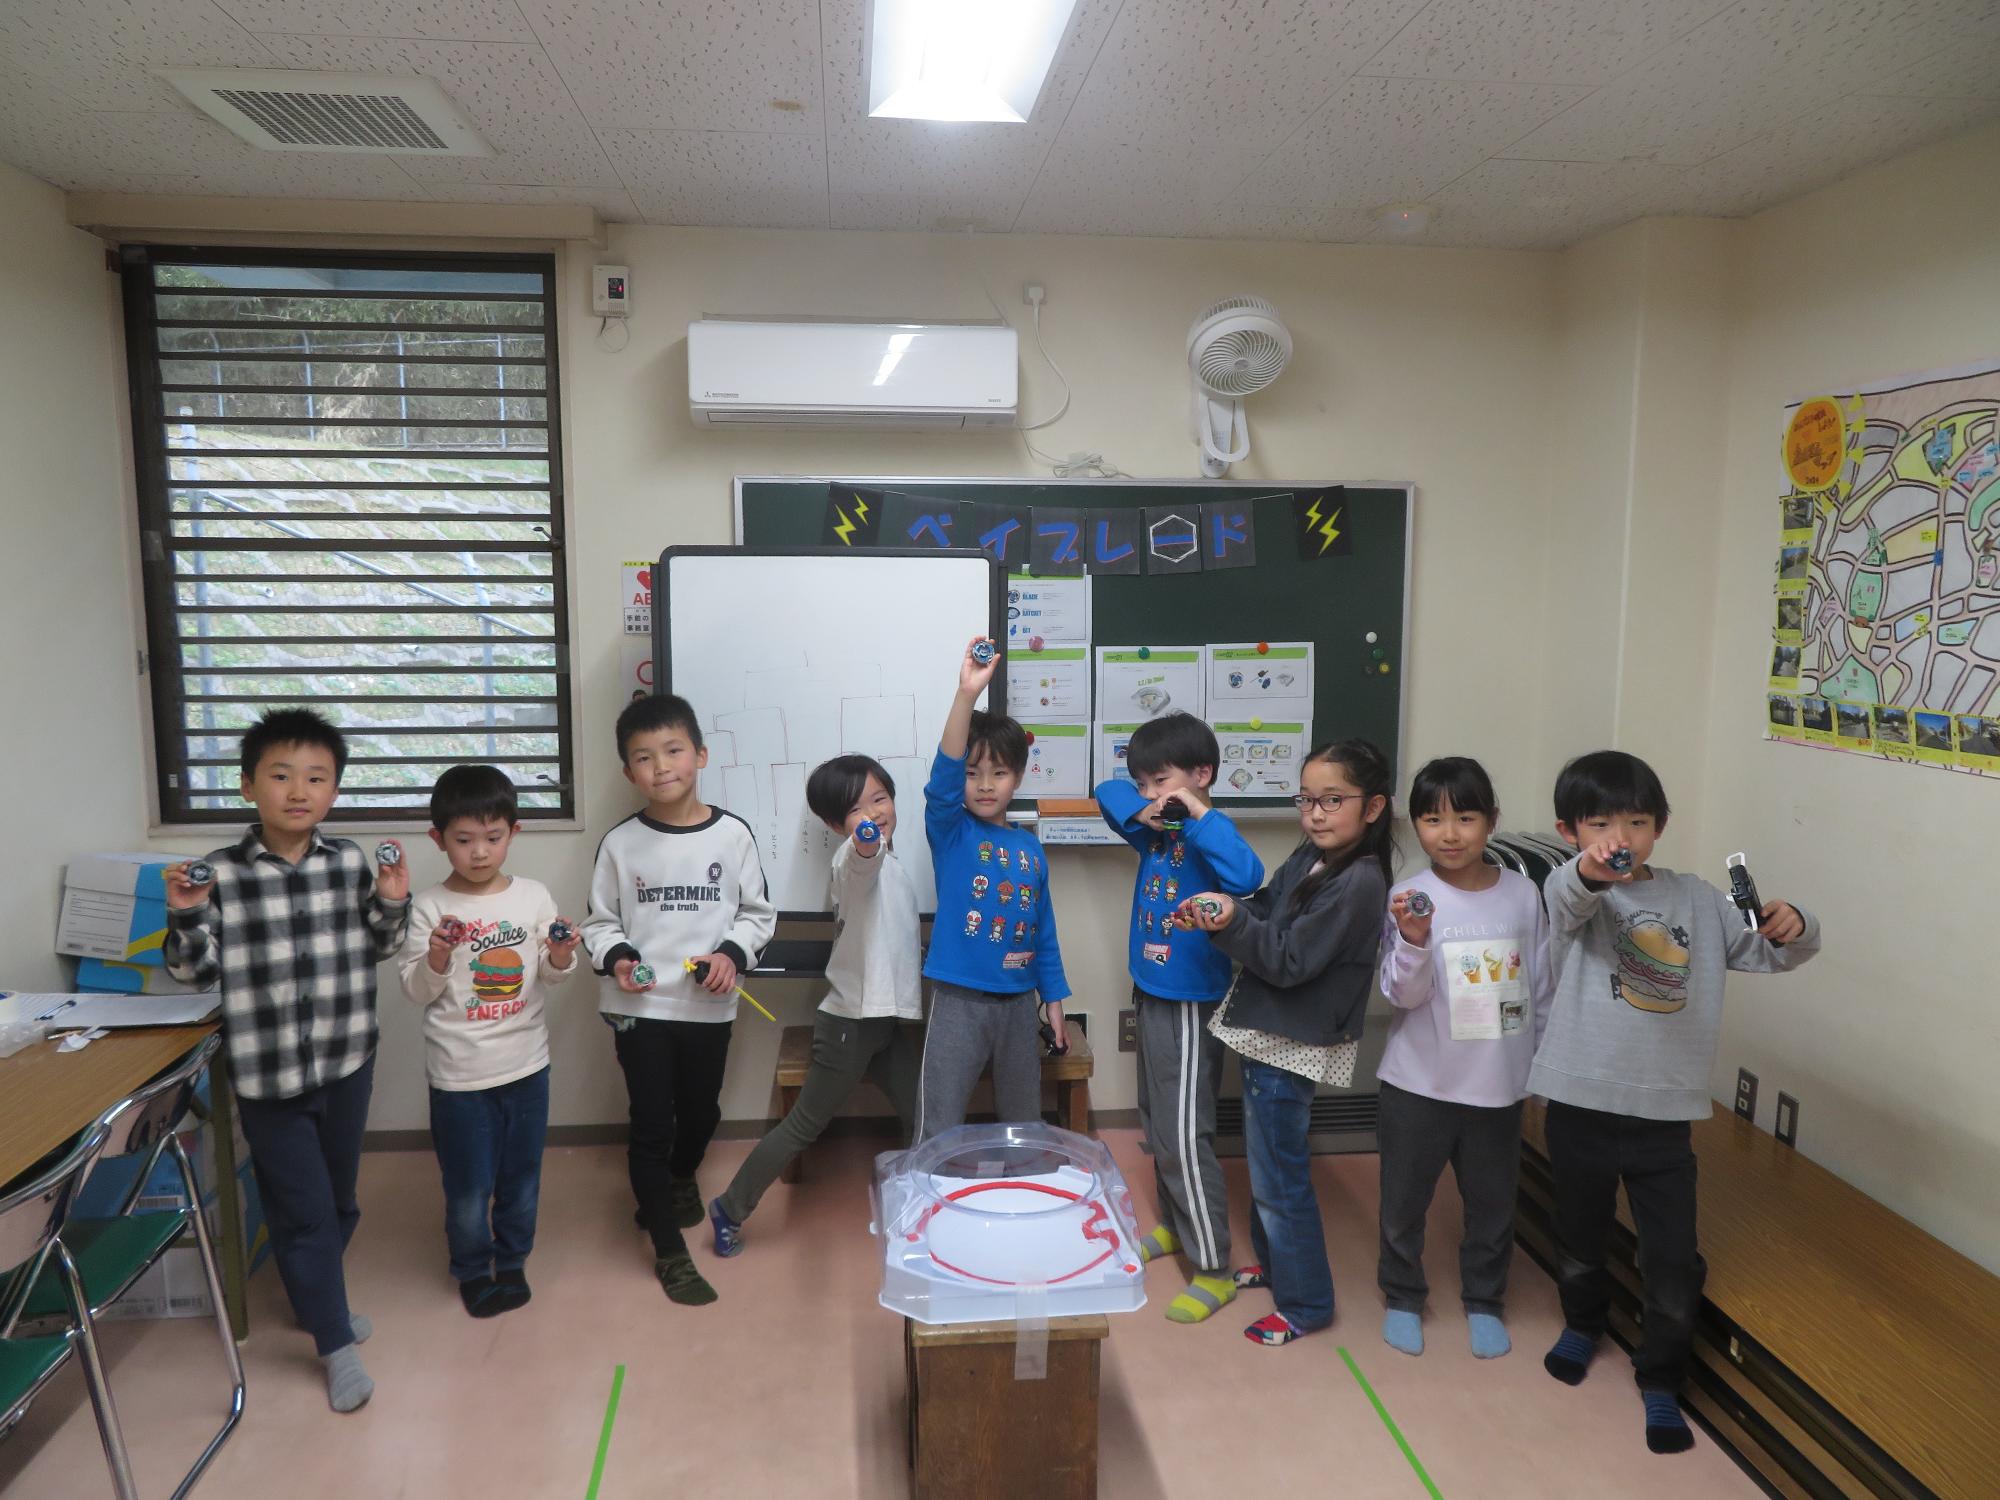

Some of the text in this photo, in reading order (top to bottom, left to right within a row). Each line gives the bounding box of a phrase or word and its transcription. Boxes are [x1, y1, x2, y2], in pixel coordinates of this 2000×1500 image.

[633, 592, 652, 605] AE
[637, 886, 721, 903] DETERMINE
[660, 902, 699, 912] the truth
[470, 926, 527, 953] Source
